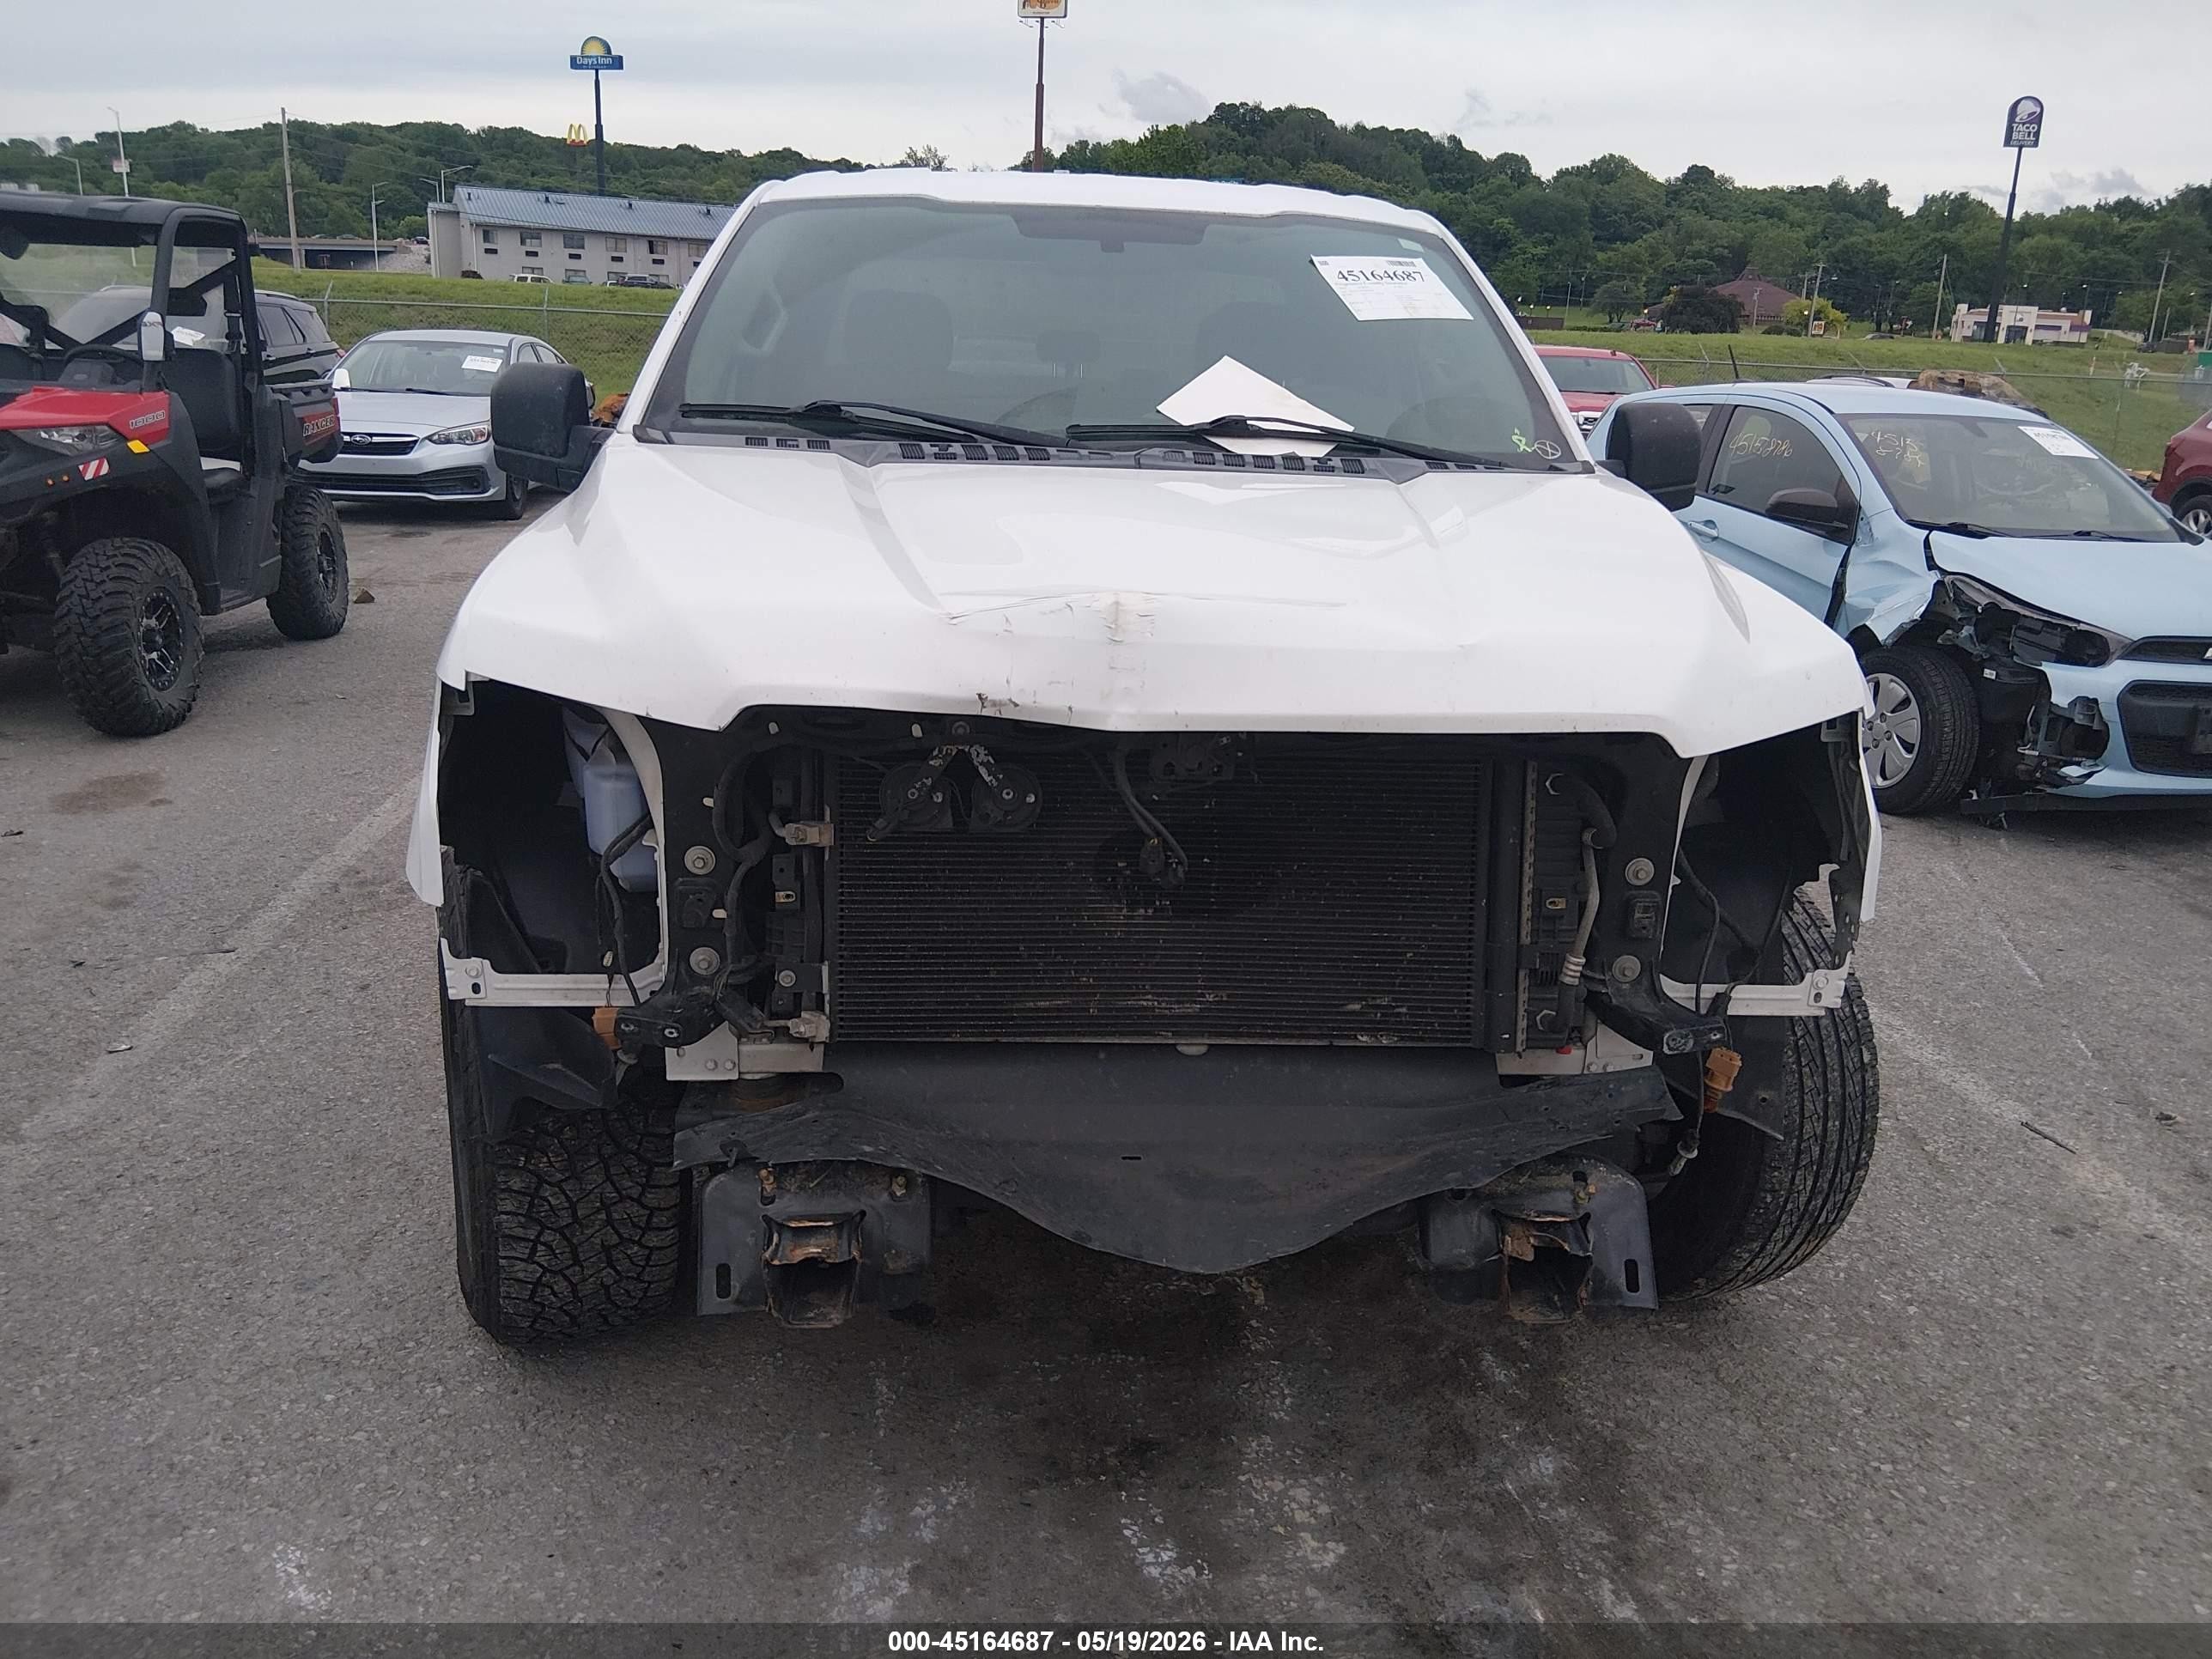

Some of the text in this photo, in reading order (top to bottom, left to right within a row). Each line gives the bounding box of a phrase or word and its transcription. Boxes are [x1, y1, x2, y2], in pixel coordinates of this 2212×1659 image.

[576, 57, 597, 65] Days
[2012, 124, 2038, 132] TACO
[1337, 270, 1425, 283] 45164687
[129, 410, 166, 429] 1000
[302, 414, 336, 437] RANGER
